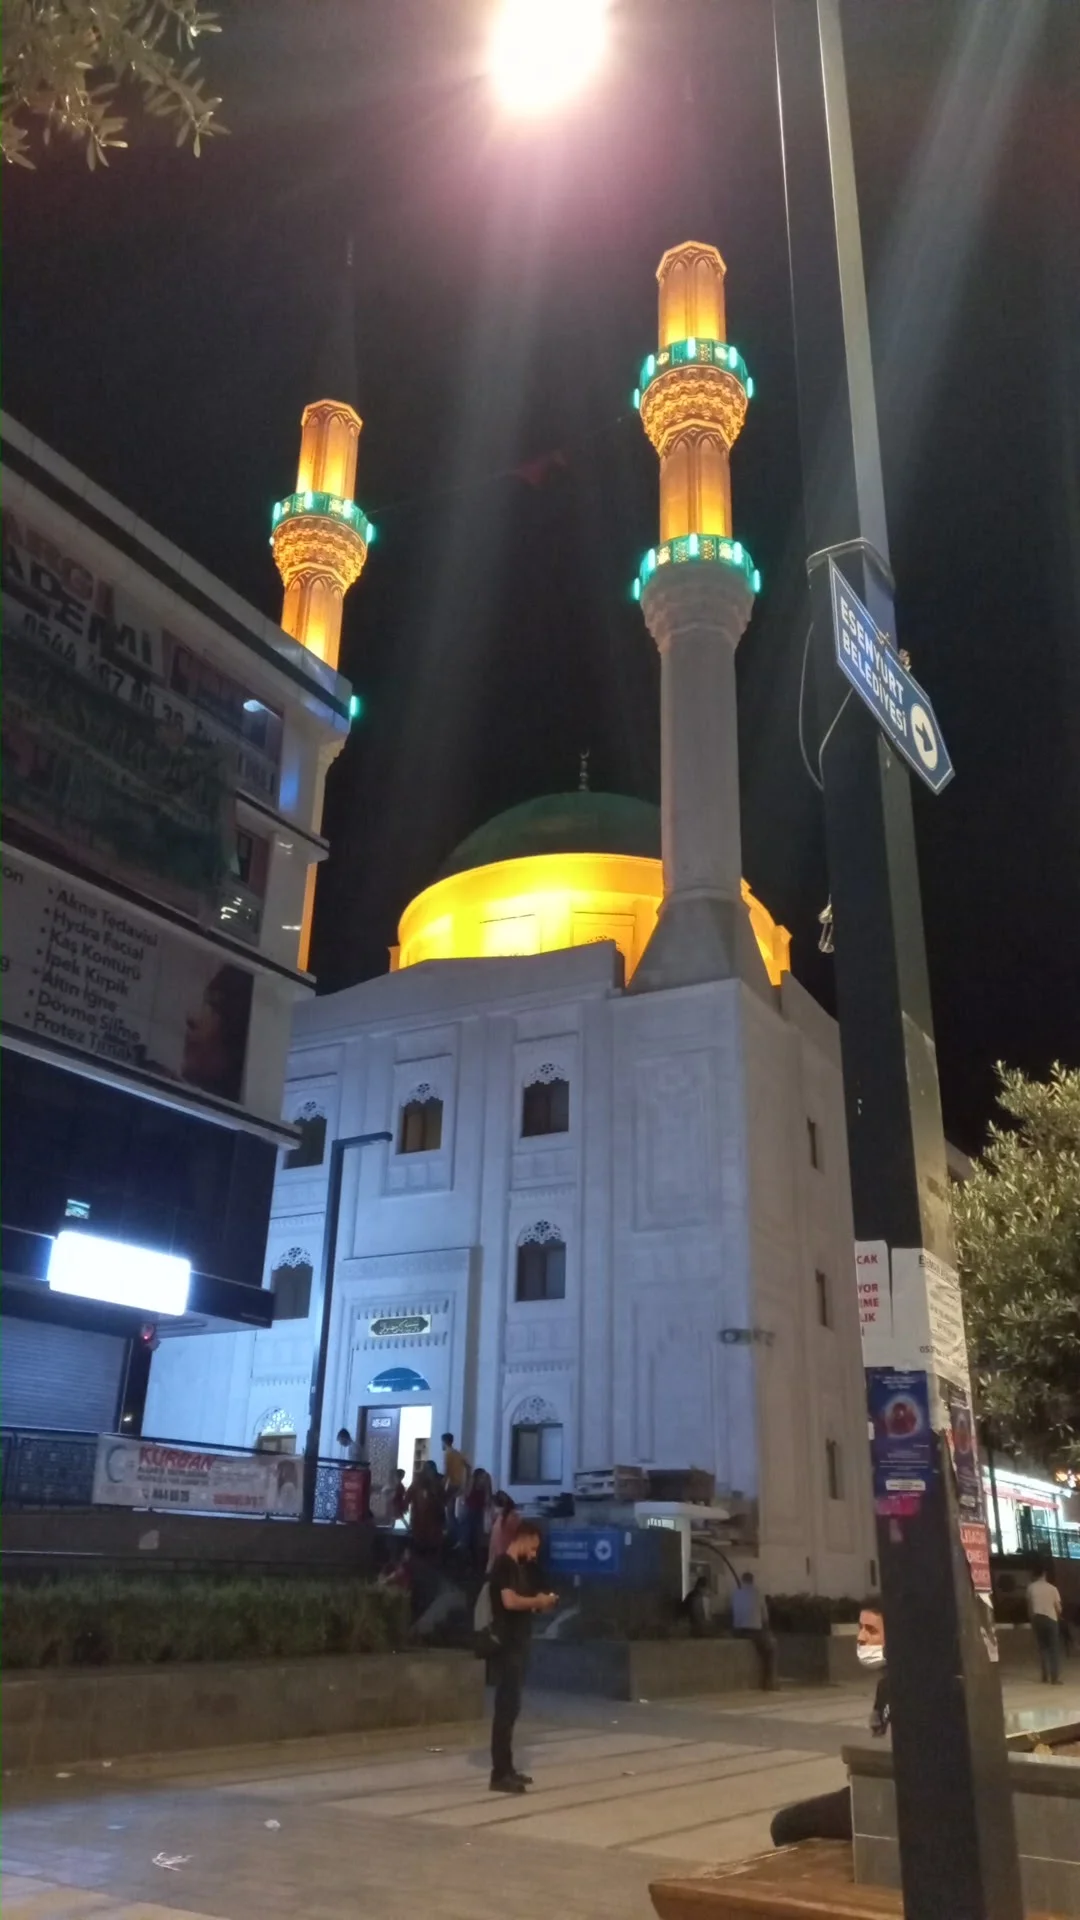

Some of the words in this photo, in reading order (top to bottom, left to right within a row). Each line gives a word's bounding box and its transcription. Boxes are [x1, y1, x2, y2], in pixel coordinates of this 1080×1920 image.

[840, 597, 904, 705] ESENYURT
[842, 628, 907, 737] BELEDİYESİ
[53, 908, 100, 942] Hydra
[103, 930, 144, 960] Facial
[57, 889, 97, 919] Akne
[102, 909, 158, 946] Tedavisi
[50, 927, 77, 956] Kaş
[85, 965, 128, 996] Kirpik
[38, 990, 96, 1026] Dövme
[34, 1011, 85, 1043] Protez
[139, 1446, 213, 1471] KURBAN
